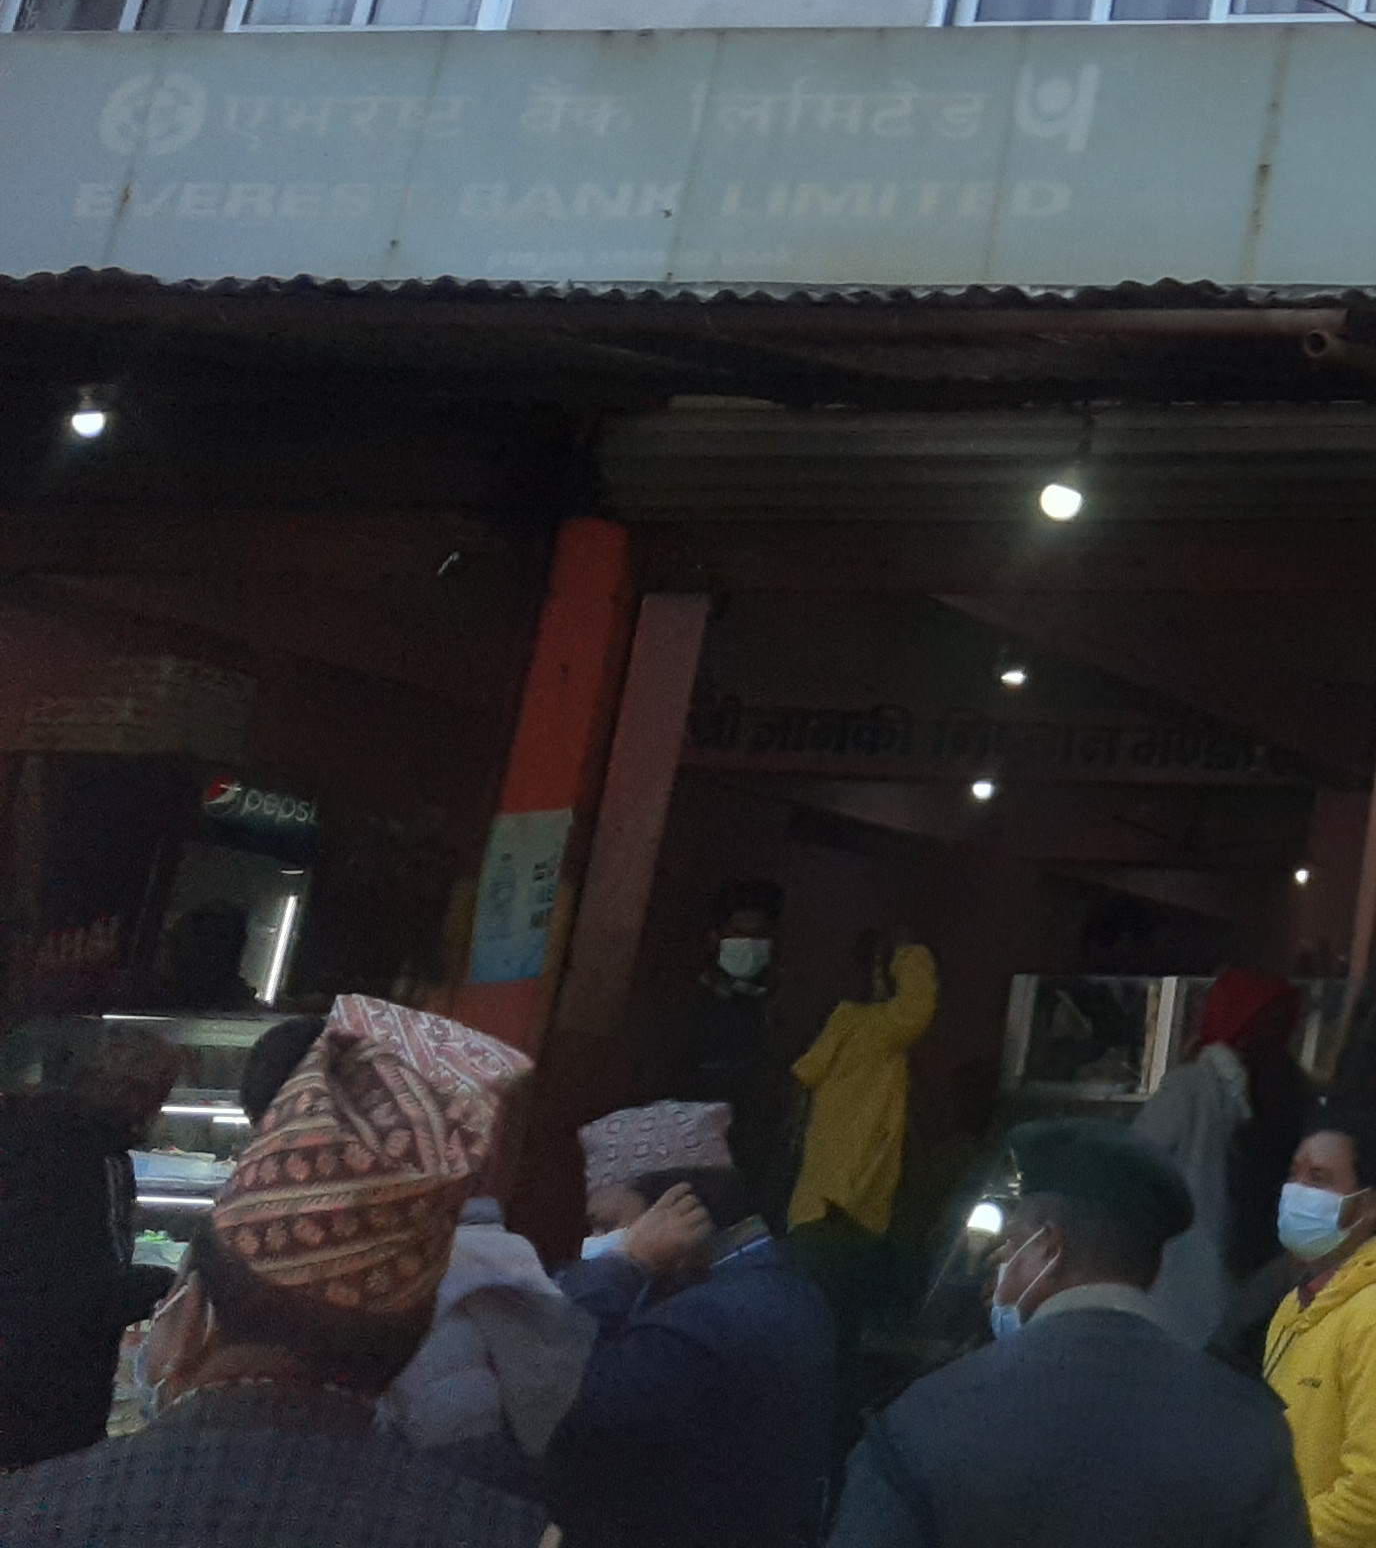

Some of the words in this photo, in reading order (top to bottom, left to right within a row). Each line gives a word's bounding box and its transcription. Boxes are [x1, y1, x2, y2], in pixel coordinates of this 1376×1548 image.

[459, 180, 688, 218] BANK
[719, 179, 1074, 218] LIMITED
[239, 788, 319, 826] pepsi
